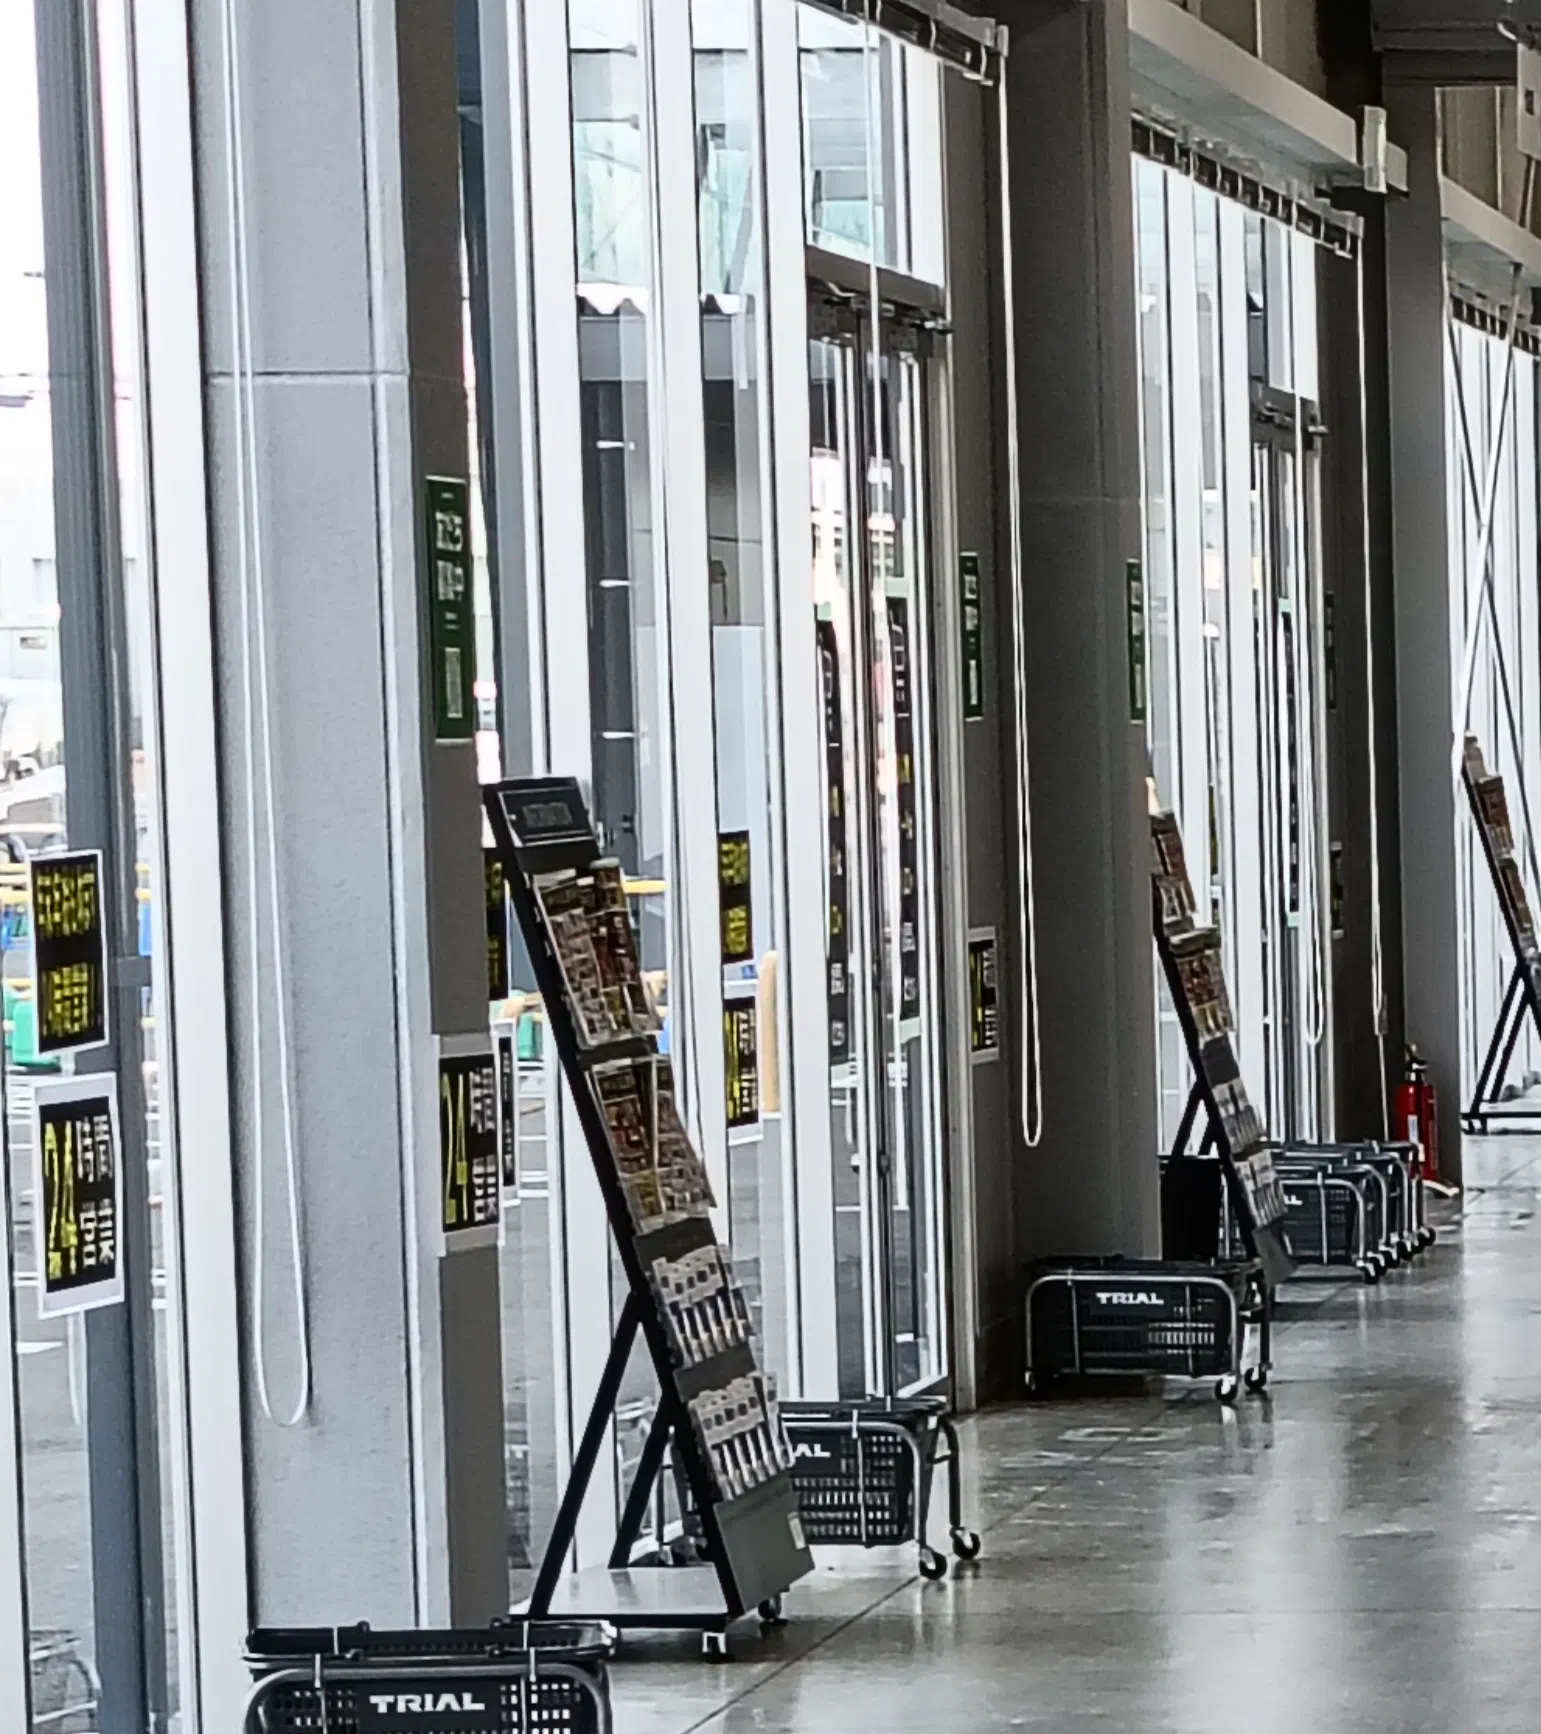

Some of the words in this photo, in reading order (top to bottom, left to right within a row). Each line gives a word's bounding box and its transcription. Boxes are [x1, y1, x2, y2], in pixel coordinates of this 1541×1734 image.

[43, 1120, 79, 1280] 24
[1096, 1291, 1165, 1305] TRIAL
[370, 1692, 486, 1713] TRIAL
